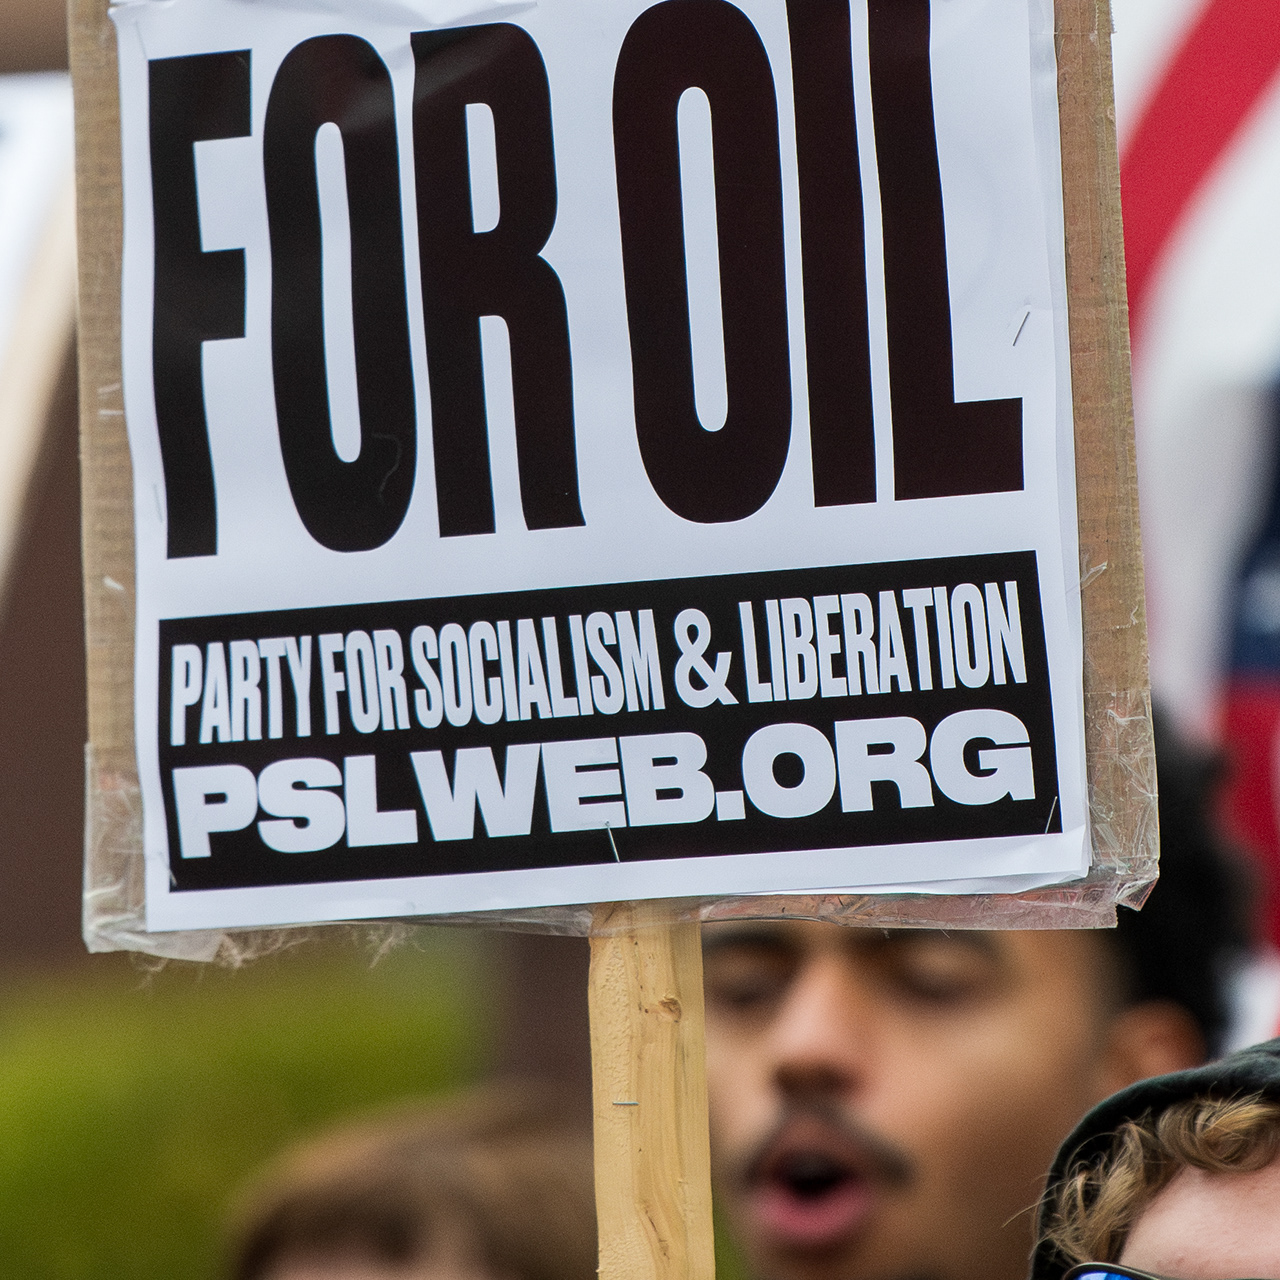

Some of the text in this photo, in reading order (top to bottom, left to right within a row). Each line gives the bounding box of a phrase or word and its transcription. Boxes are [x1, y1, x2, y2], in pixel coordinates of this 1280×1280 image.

[147, 21, 587, 560] FOR
[170, 580, 1028, 747] PARTY FOR SOCIALISM & LIBERATION
[172, 708, 1036, 860] PSLWEB.ORG
